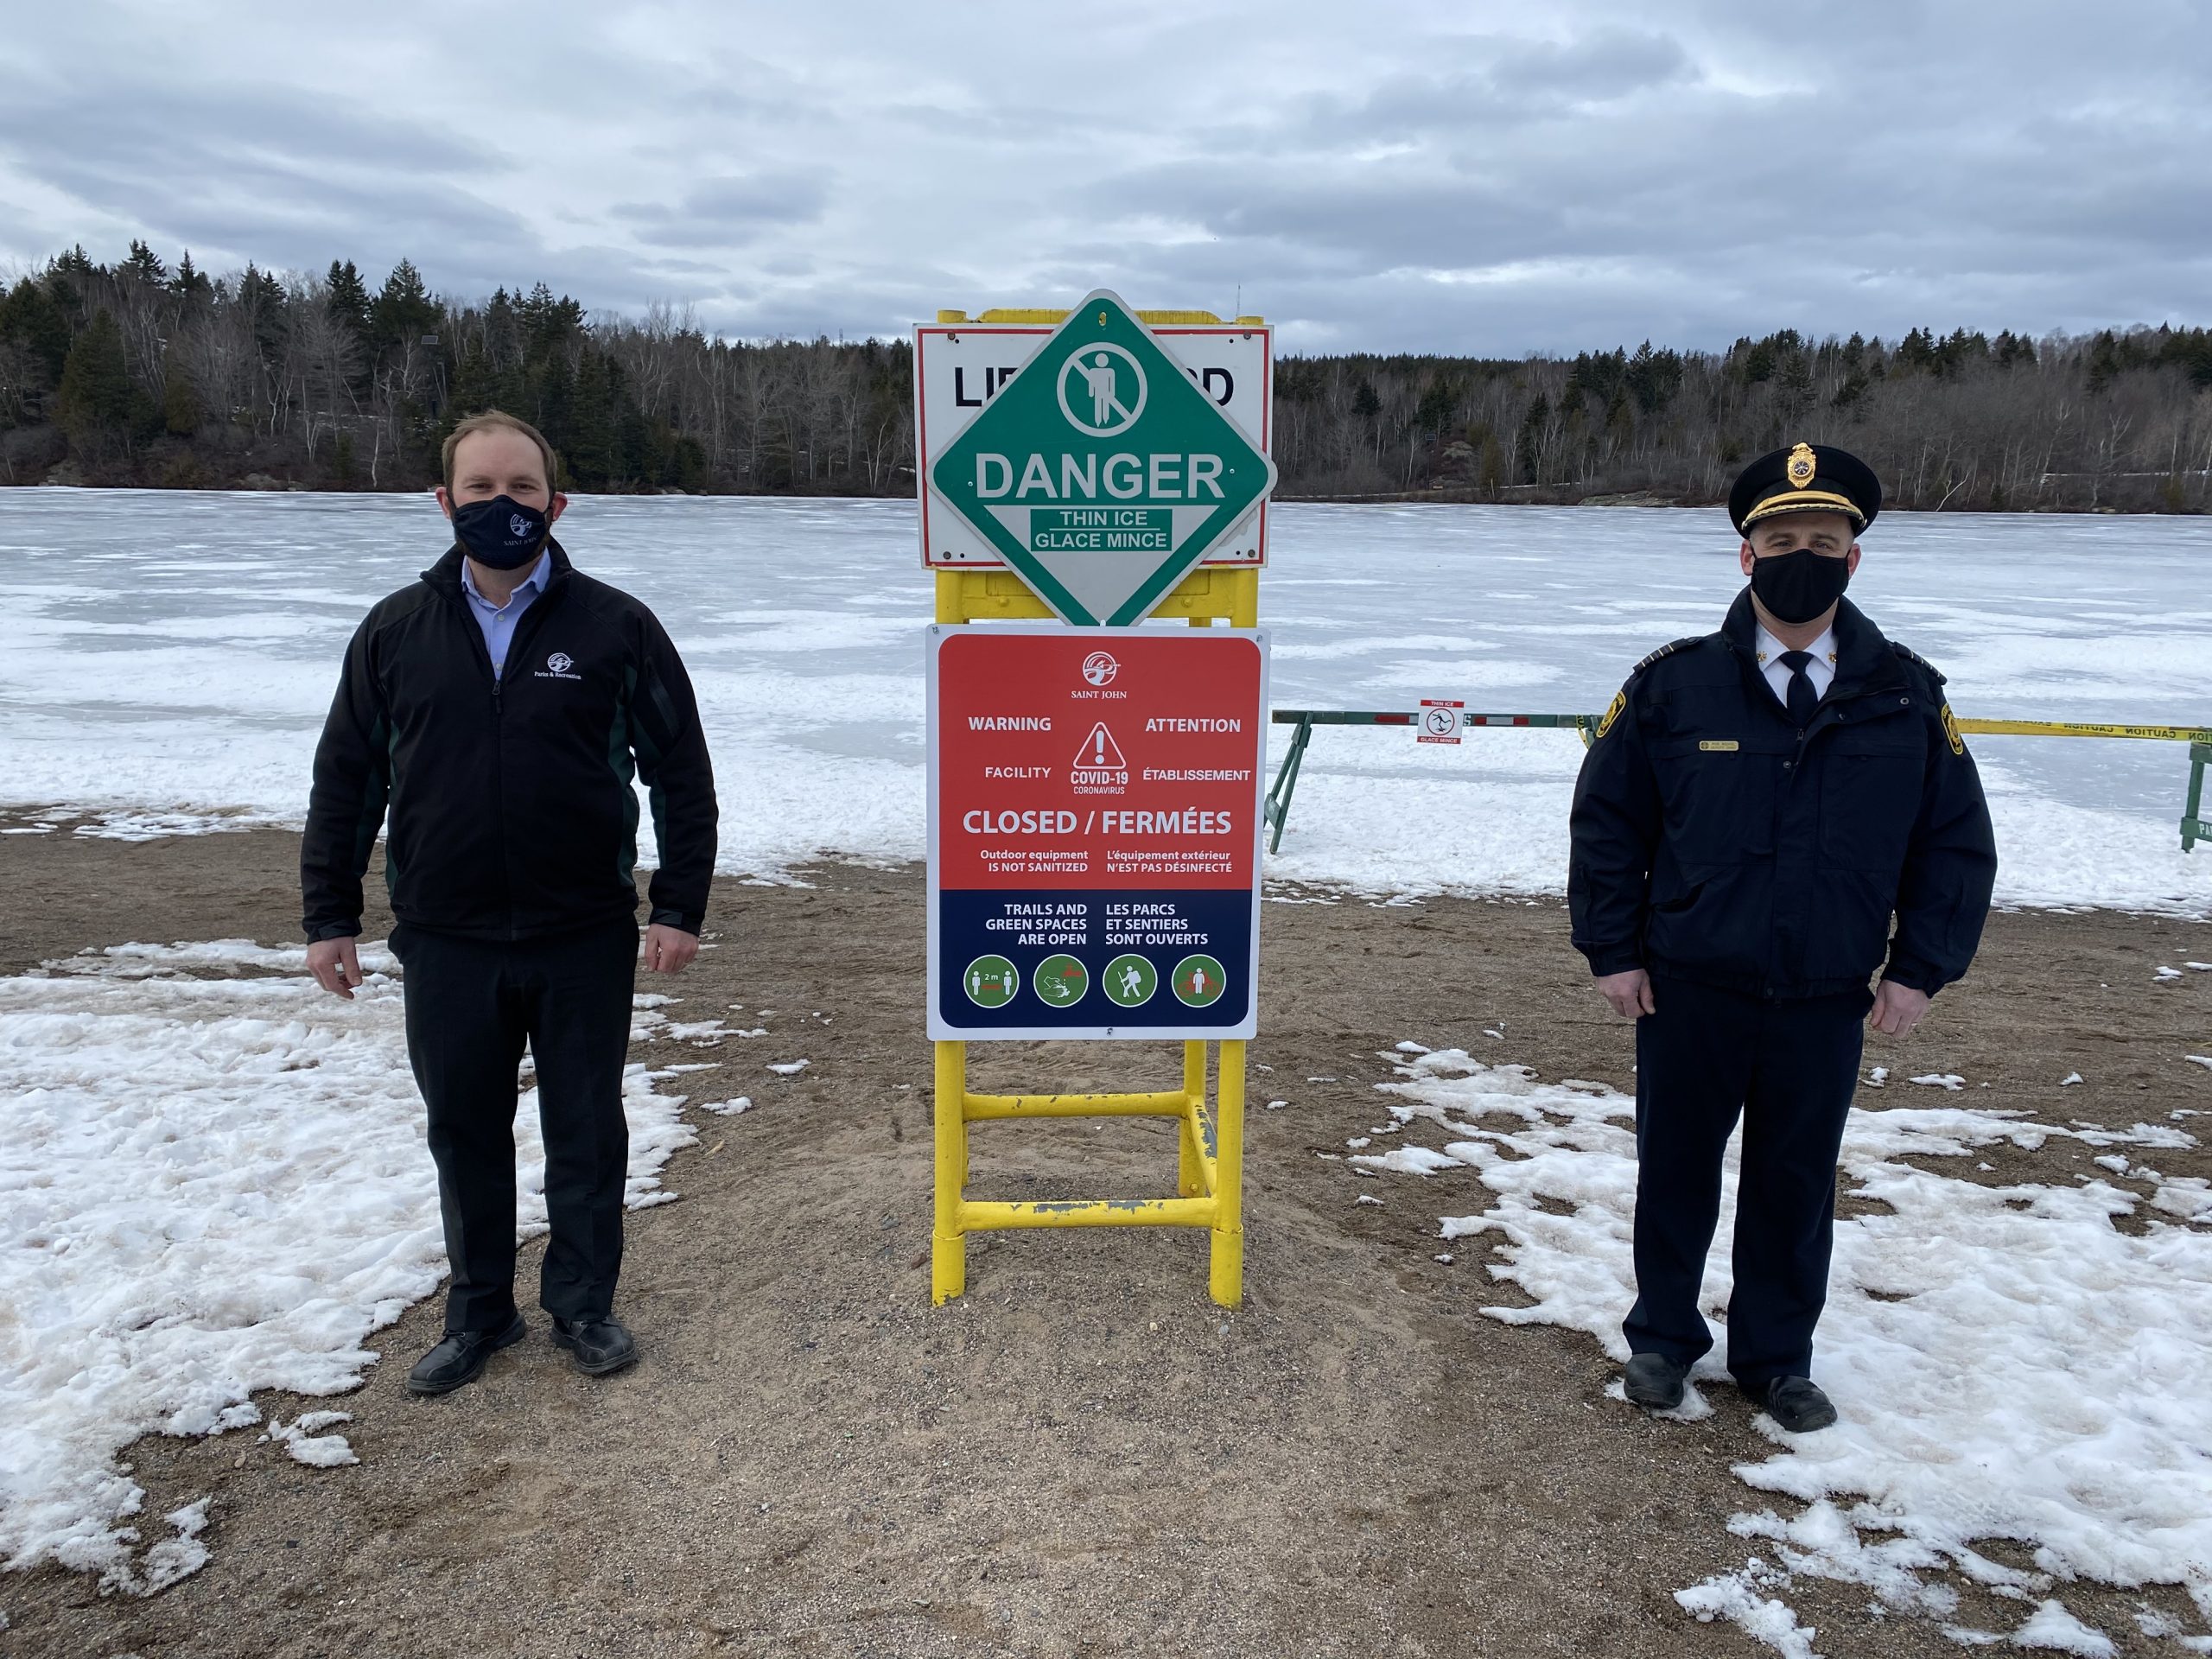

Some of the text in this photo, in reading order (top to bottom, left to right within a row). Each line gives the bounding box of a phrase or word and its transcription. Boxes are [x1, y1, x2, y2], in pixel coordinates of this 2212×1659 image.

[976, 453, 1225, 499] DANGER
[1060, 511, 1148, 526] THIN ICE
[1035, 532, 1167, 548] GLACE MINCE
[1071, 690, 1128, 700] SAINT JOHN
[968, 717, 1052, 731] WARNING
[1145, 718, 1241, 733] ATTENTION
[985, 766, 1052, 779] FACILITY
[1071, 771, 1128, 785] COVID-19
[1142, 767, 1251, 781] ÉTABLISSEMENT
[1073, 785, 1125, 795] CORONAVIRUS
[963, 810, 1077, 834] CLOSED
[1103, 806, 1232, 835] FERMÉES
[980, 849, 1089, 862] Outdoor equipment
[1181, 850, 1230, 861] extérieur
[988, 862, 1089, 873] IS NOT SANITIZED
[1141, 862, 1162, 873] PAS
[1165, 861, 1232, 873] DÉSINFECTÉ
[1004, 904, 1087, 916] TRAILS AND
[1106, 904, 1176, 916] LES PARCS
[985, 918, 1087, 931] GREEN SPACES
[1106, 918, 1188, 931] ET SENTIERS
[1018, 933, 1087, 945] ARE OPEN
[1105, 933, 1209, 945] SONT OUVERTS
